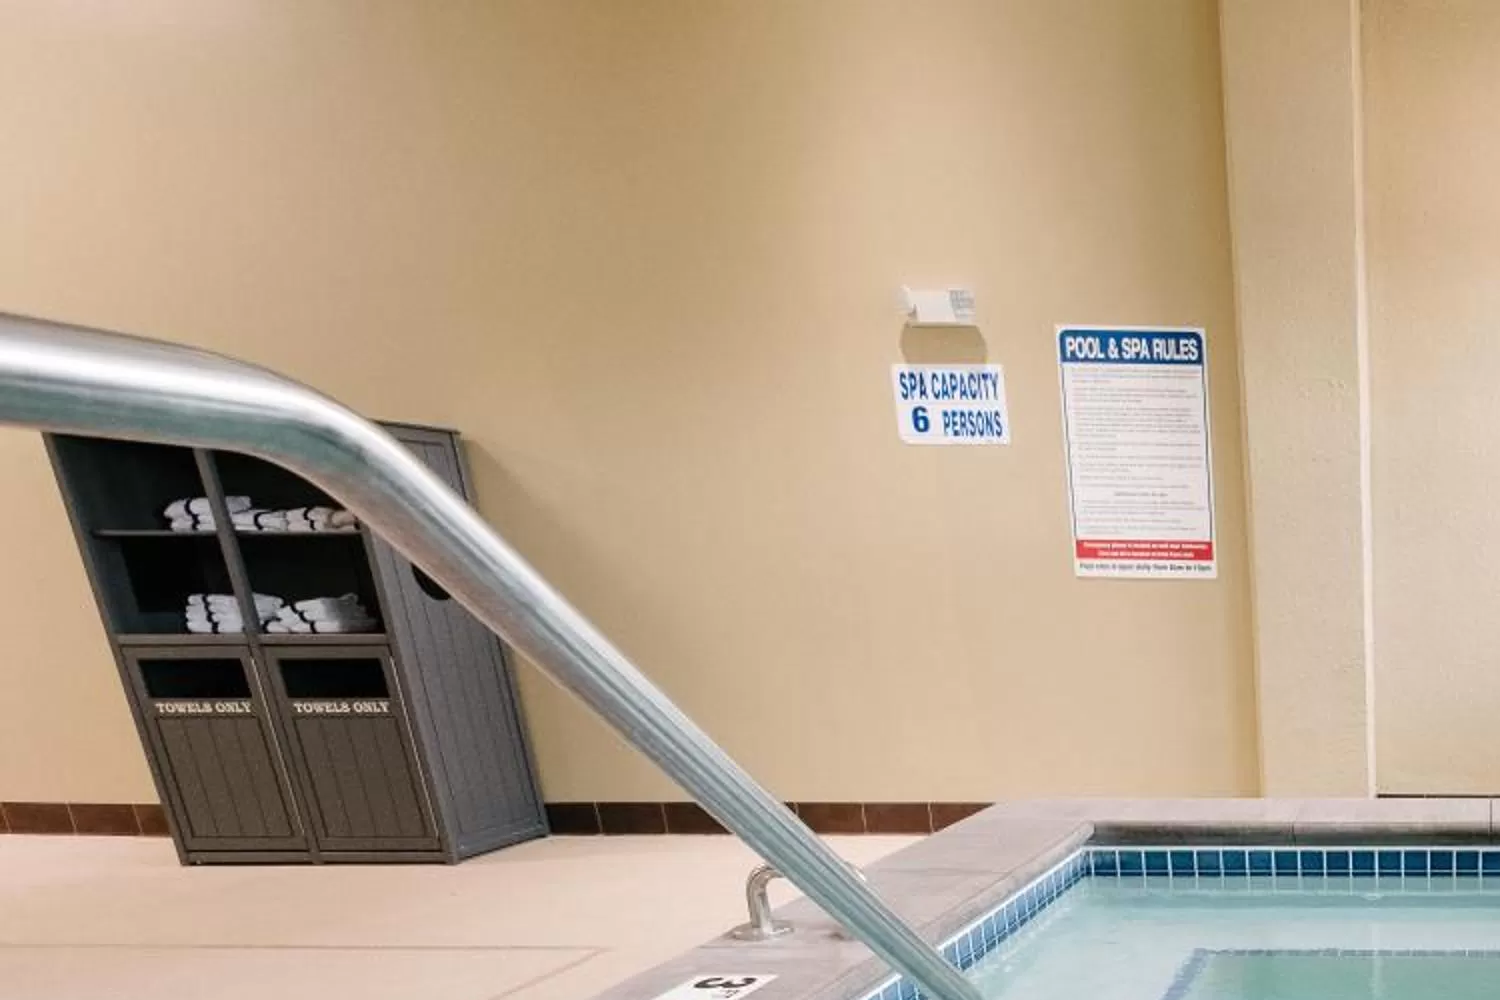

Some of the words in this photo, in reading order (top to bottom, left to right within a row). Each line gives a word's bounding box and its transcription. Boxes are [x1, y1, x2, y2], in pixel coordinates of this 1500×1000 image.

[1065, 336, 1105, 359] POOL
[1107, 337, 1120, 359] &
[1121, 337, 1150, 360] SPA
[1152, 338, 1199, 361] RULES
[899, 371, 929, 400] SPA
[931, 371, 998, 400] CAPACITY
[911, 405, 930, 433] 6
[942, 408, 1003, 437] PERSONS
[155, 701, 213, 713] TOWELS
[215, 701, 252, 713] ONLY
[293, 701, 351, 713] TOWELS
[353, 701, 390, 713] ONLY
